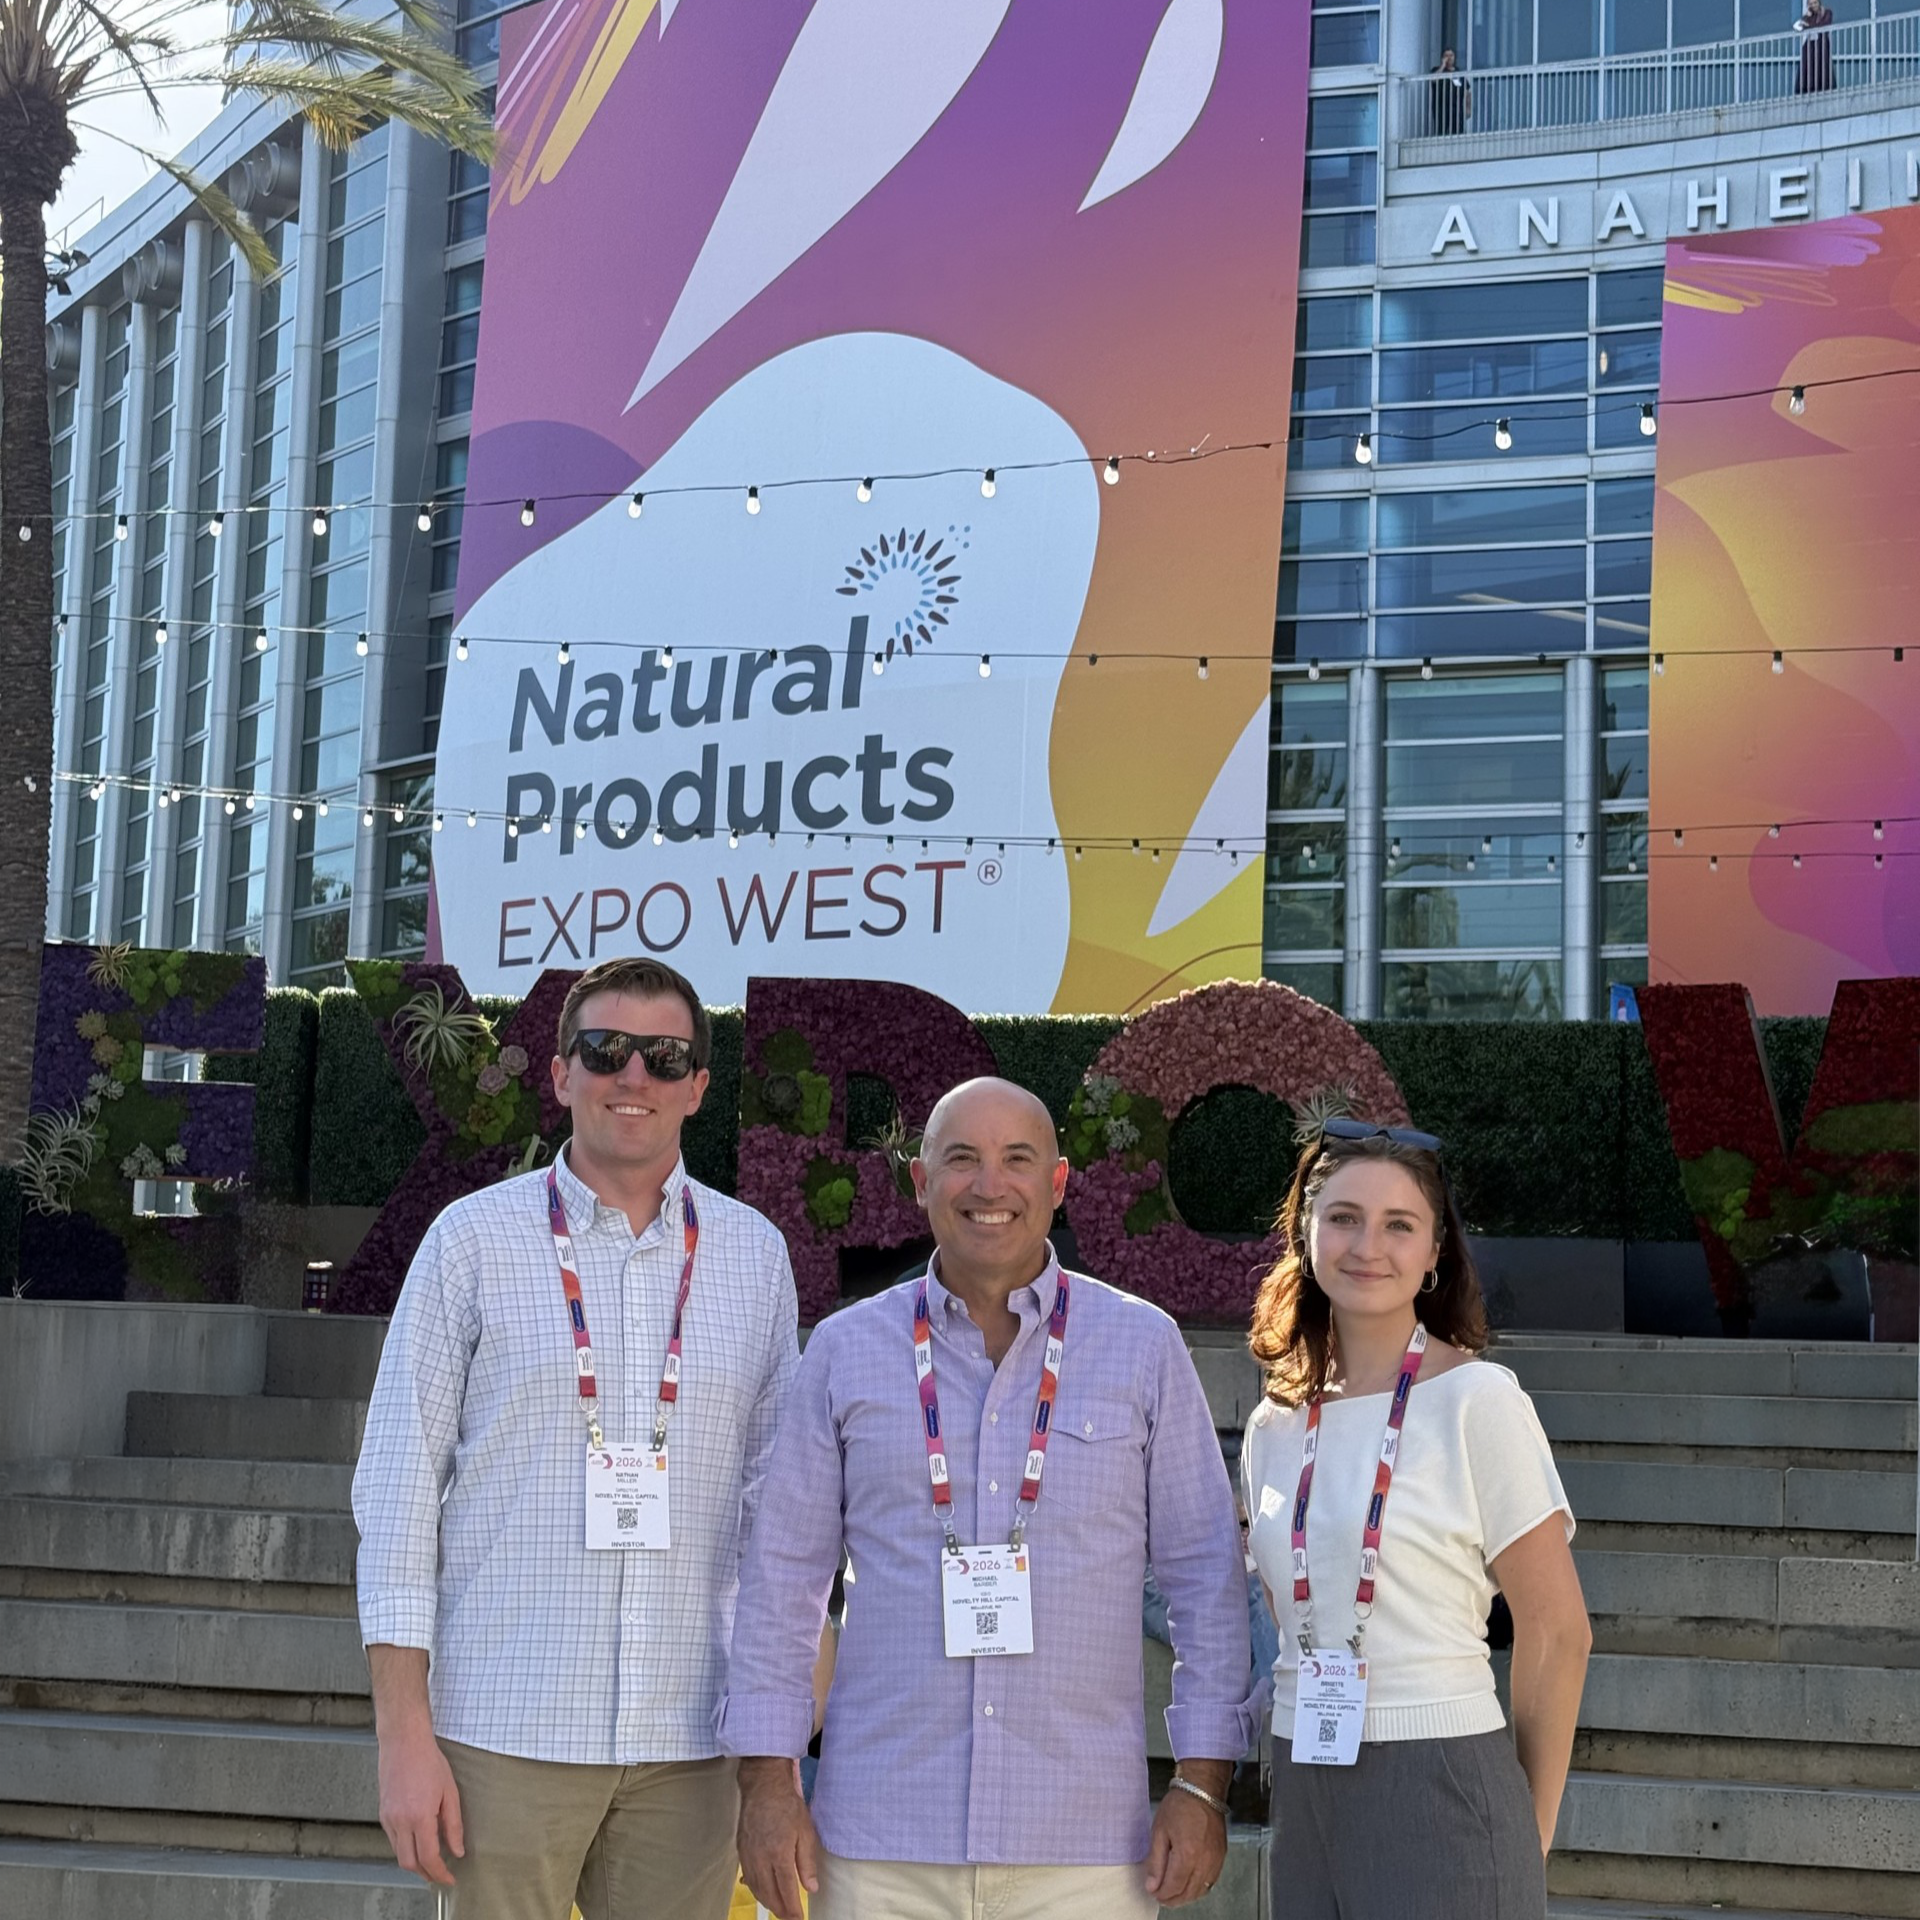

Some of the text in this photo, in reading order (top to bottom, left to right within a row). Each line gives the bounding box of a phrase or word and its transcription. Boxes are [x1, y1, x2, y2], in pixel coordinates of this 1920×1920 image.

[1431, 150, 1920, 255] ANAHEI
[508, 615, 869, 753] Natural
[503, 734, 954, 864] Products
[498, 881, 692, 968] EXPO
[616, 1457, 643, 1468] 2026
[972, 1560, 1001, 1571] 2026
[971, 1646, 1007, 1655] INVESTOR
[1323, 1664, 1347, 1676] 2026
[1337, 1704, 1358, 1712] CAPITAL
[1311, 1755, 1339, 1763] INVESTOR
